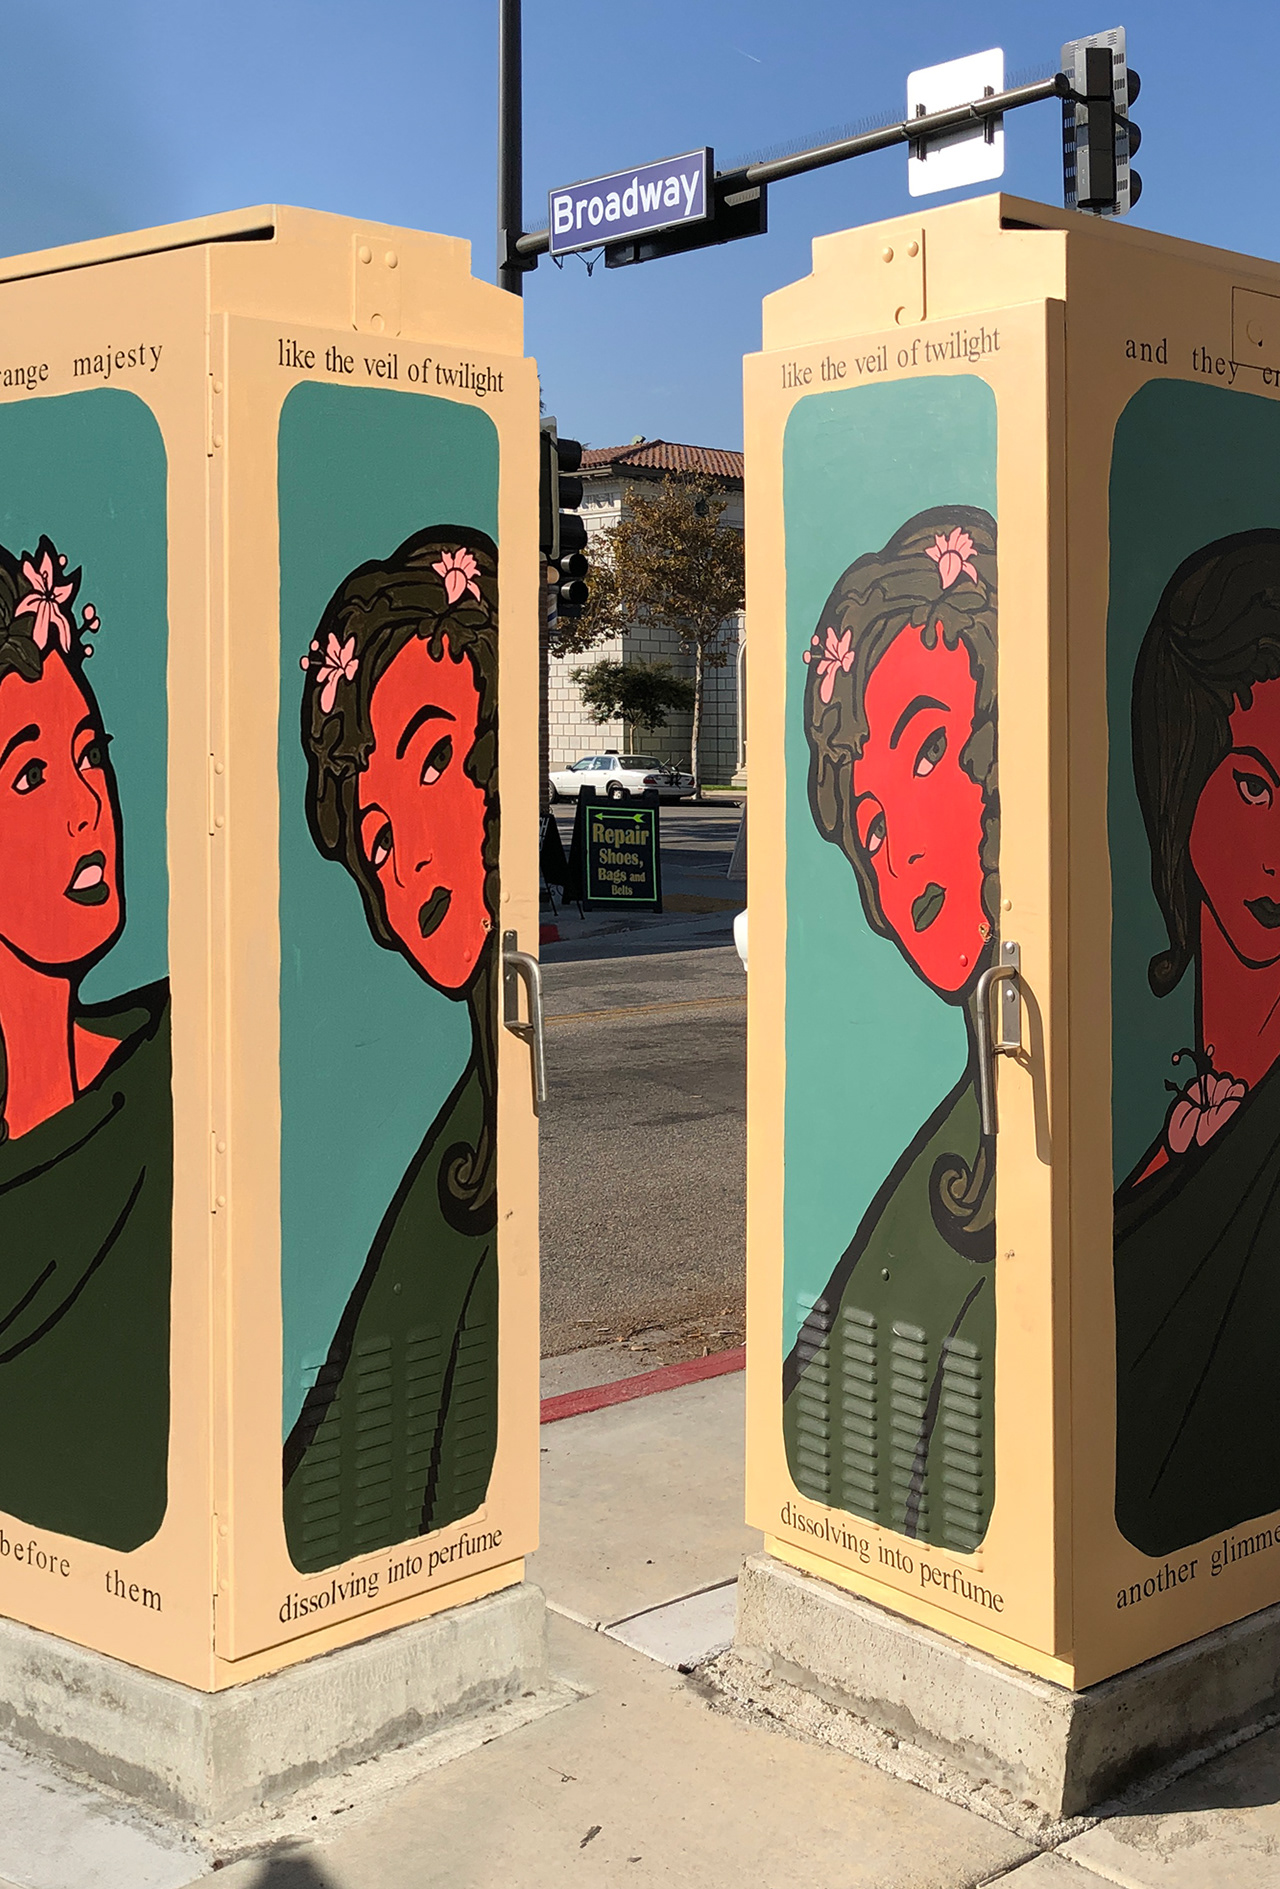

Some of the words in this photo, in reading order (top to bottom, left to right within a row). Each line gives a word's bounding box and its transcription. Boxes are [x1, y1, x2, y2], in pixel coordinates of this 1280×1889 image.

[554, 170, 700, 234] Broadway
[73, 342, 163, 380] majesty
[278, 338, 316, 369] like
[325, 346, 354, 374] the
[364, 353, 399, 380] veil
[407, 358, 432, 383] of
[436, 362, 504, 397] twilight
[782, 362, 812, 389] like
[821, 356, 847, 382] the
[855, 345, 888, 374] veil
[897, 338, 921, 368] of
[925, 327, 1001, 362] twilight
[1125, 338, 1169, 365] and
[1192, 347, 1239, 385] they
[592, 823, 649, 848] Repair
[599, 848, 643, 868] Shoes,
[598, 868, 627, 884] Bags
[630, 872, 645, 882] and
[611, 885, 633, 895] Belts
[0, 1530, 70, 1577] before
[105, 1569, 162, 1612] them
[278, 1572, 379, 1623] dissolving
[387, 1555, 423, 1584] into
[427, 1529, 503, 1577] perfume
[780, 1501, 871, 1564] dissolving
[878, 1538, 914, 1574] into
[919, 1562, 1005, 1613] perfume
[1116, 1558, 1198, 1610] another
